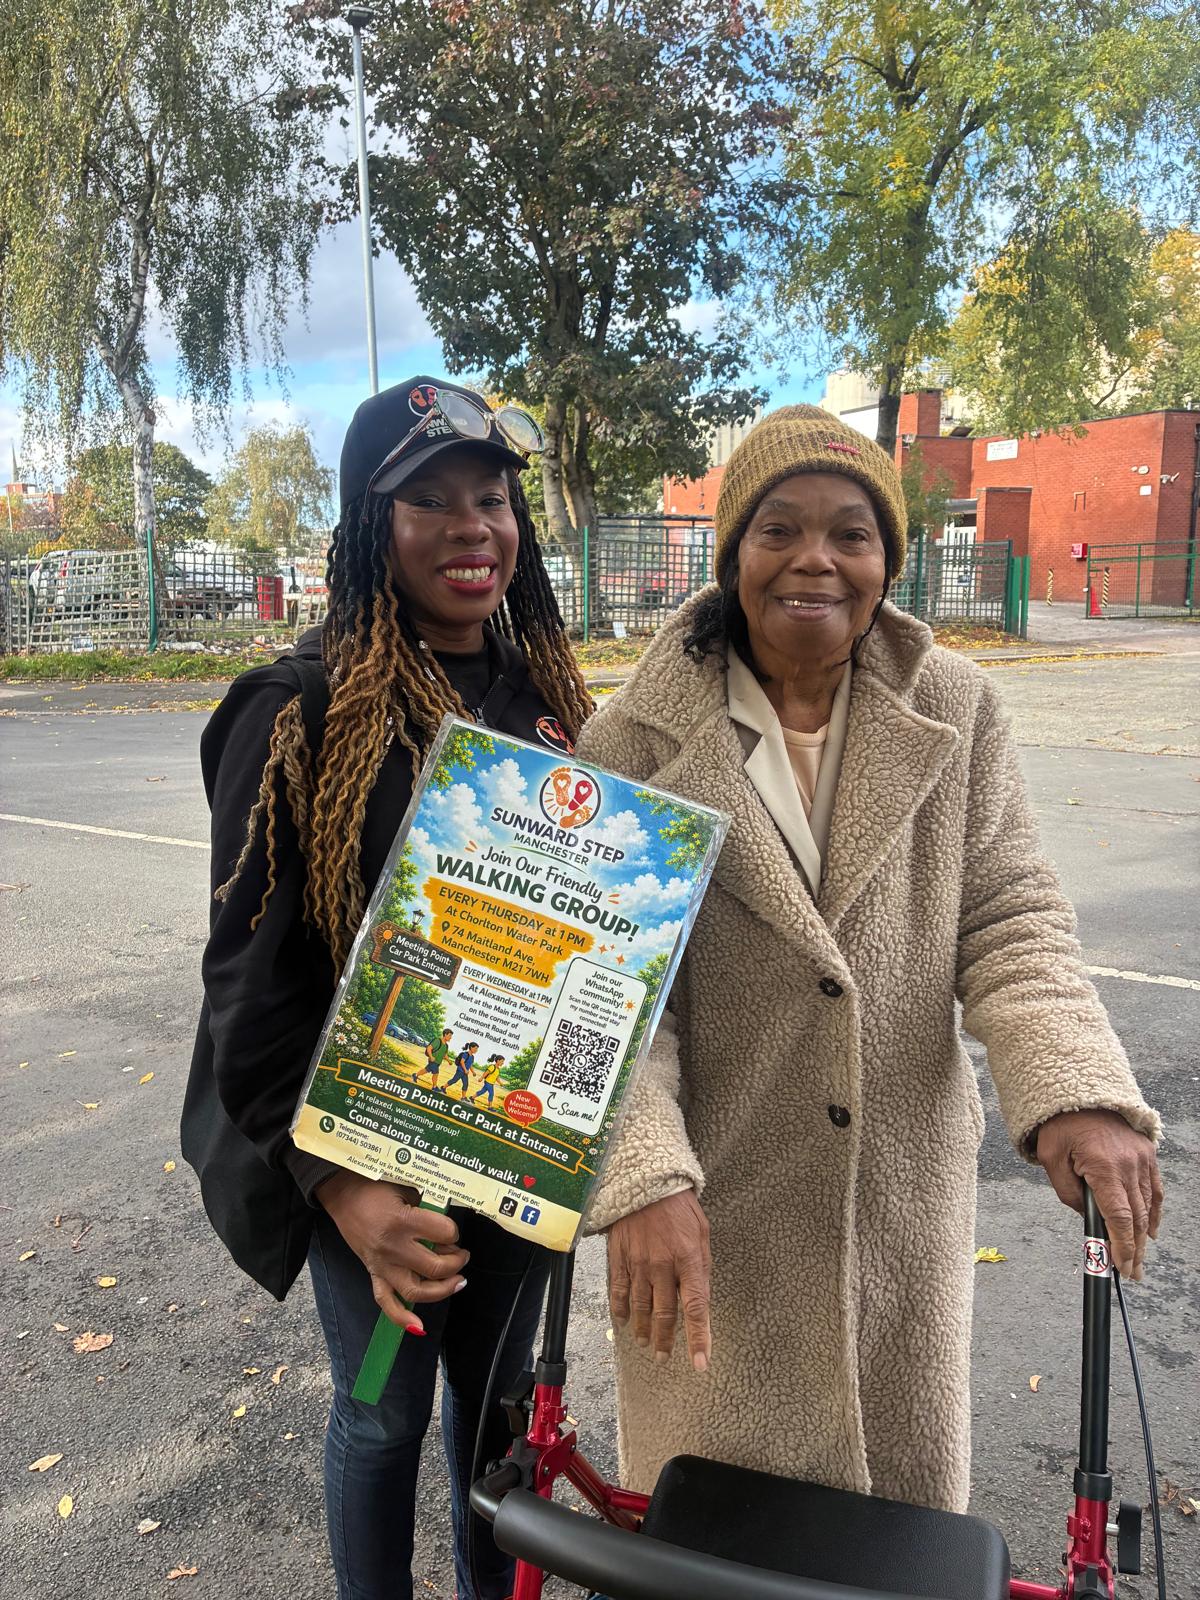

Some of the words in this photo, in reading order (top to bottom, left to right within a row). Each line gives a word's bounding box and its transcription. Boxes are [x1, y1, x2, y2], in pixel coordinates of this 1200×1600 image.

[426, 426, 453, 438] STE
[491, 807, 579, 848] SUNWARD
[582, 838, 625, 864] STEP
[514, 832, 590, 866] MANCHESTER
[482, 846, 512, 867] Join
[516, 856, 542, 876] Our
[546, 865, 603, 904] Friendly
[436, 854, 547, 904] WALKING
[550, 892, 640, 943] GROUP!
[439, 886, 478, 908] EVERY
[481, 901, 545, 932] THURSDAY
[545, 925, 558, 938] at
[560, 930, 566, 940] 1
[567, 932, 586, 947] PM
[444, 906, 458, 917] At
[460, 910, 504, 934] Chorlton
[506, 926, 538, 946] Water
[540, 938, 564, 956] Park
[389, 945, 404, 956] Car
[404, 950, 420, 964] Park
[422, 958, 452, 976] Entrance
[396, 935, 429, 957] Meeting
[430, 950, 452, 966] Point:
[442, 936, 501, 966] Manchester
[502, 960, 524, 974] M21
[525, 966, 550, 983] 7WH
[452, 926, 465, 938] 74
[466, 930, 512, 956] Maitland
[514, 947, 536, 966] Ave,
[463, 966, 486, 980] EVERY
[486, 974, 529, 996] WEDNESDAY
[540, 995, 552, 1005] PM
[585, 978, 624, 999] WhatsApp
[592, 971, 608, 982] Join
[609, 978, 623, 988] our
[457, 992, 474, 1002] Meet
[481, 1000, 492, 1010] the
[493, 1005, 510, 1016] Main
[510, 1011, 538, 1026] Entrance
[468, 984, 478, 993] At
[478, 988, 518, 1008] Alexandra
[518, 1002, 537, 1015] Park
[578, 1007, 598, 1018] number
[579, 988, 624, 1008] community!
[590, 1002, 600, 1010] QR
[600, 1006, 612, 1015] code
[459, 1012, 491, 1029] Claremont
[491, 1024, 507, 1036] Road
[508, 1032, 520, 1040] and
[478, 1009, 489, 1018] the
[489, 1015, 510, 1026] corner
[579, 1015, 607, 1028] connected!
[453, 1020, 484, 1037] Alexandra
[484, 1032, 501, 1044] Road
[501, 1038, 520, 1051] South
[508, 1106, 538, 1119] Welcome!
[510, 1100, 537, 1112] Members
[516, 1094, 531, 1103] New
[558, 1102, 579, 1118] Scan
[581, 1110, 599, 1122] me!
[355, 1101, 366, 1110] All
[366, 1104, 392, 1120] abilities
[393, 1116, 425, 1135] welcome.
[358, 1091, 365, 1099] A
[365, 1093, 394, 1112] relaxed,
[395, 1106, 434, 1129] welcoming
[435, 1121, 460, 1137] group!
[358, 1068, 408, 1099] Meeting
[410, 1087, 449, 1112] Point:
[451, 1104, 472, 1122] Car
[475, 1114, 503, 1135] Park
[504, 1128, 517, 1140] at
[519, 1134, 569, 1162] Entrance
[336, 1130, 358, 1146] (07344)
[360, 1141, 382, 1154] 503861
[339, 1123, 370, 1140] Telephone:
[349, 1109, 379, 1130] Come
[381, 1123, 411, 1145] along
[414, 1136, 430, 1150] for
[432, 1145, 439, 1154] a
[440, 1148, 486, 1173] friendly
[488, 1166, 520, 1185] walk!
[415, 1153, 440, 1169] Website:
[347, 1156, 378, 1173] Alexandra
[379, 1169, 393, 1178] Park
[365, 1154, 379, 1164] Find
[394, 1166, 404, 1175] the
[415, 1175, 430, 1185] park
[438, 1184, 448, 1193] the
[449, 1189, 476, 1204] entrance
[411, 1162, 466, 1188] Sunwardstep.com
[508, 1189, 521, 1198] Find
